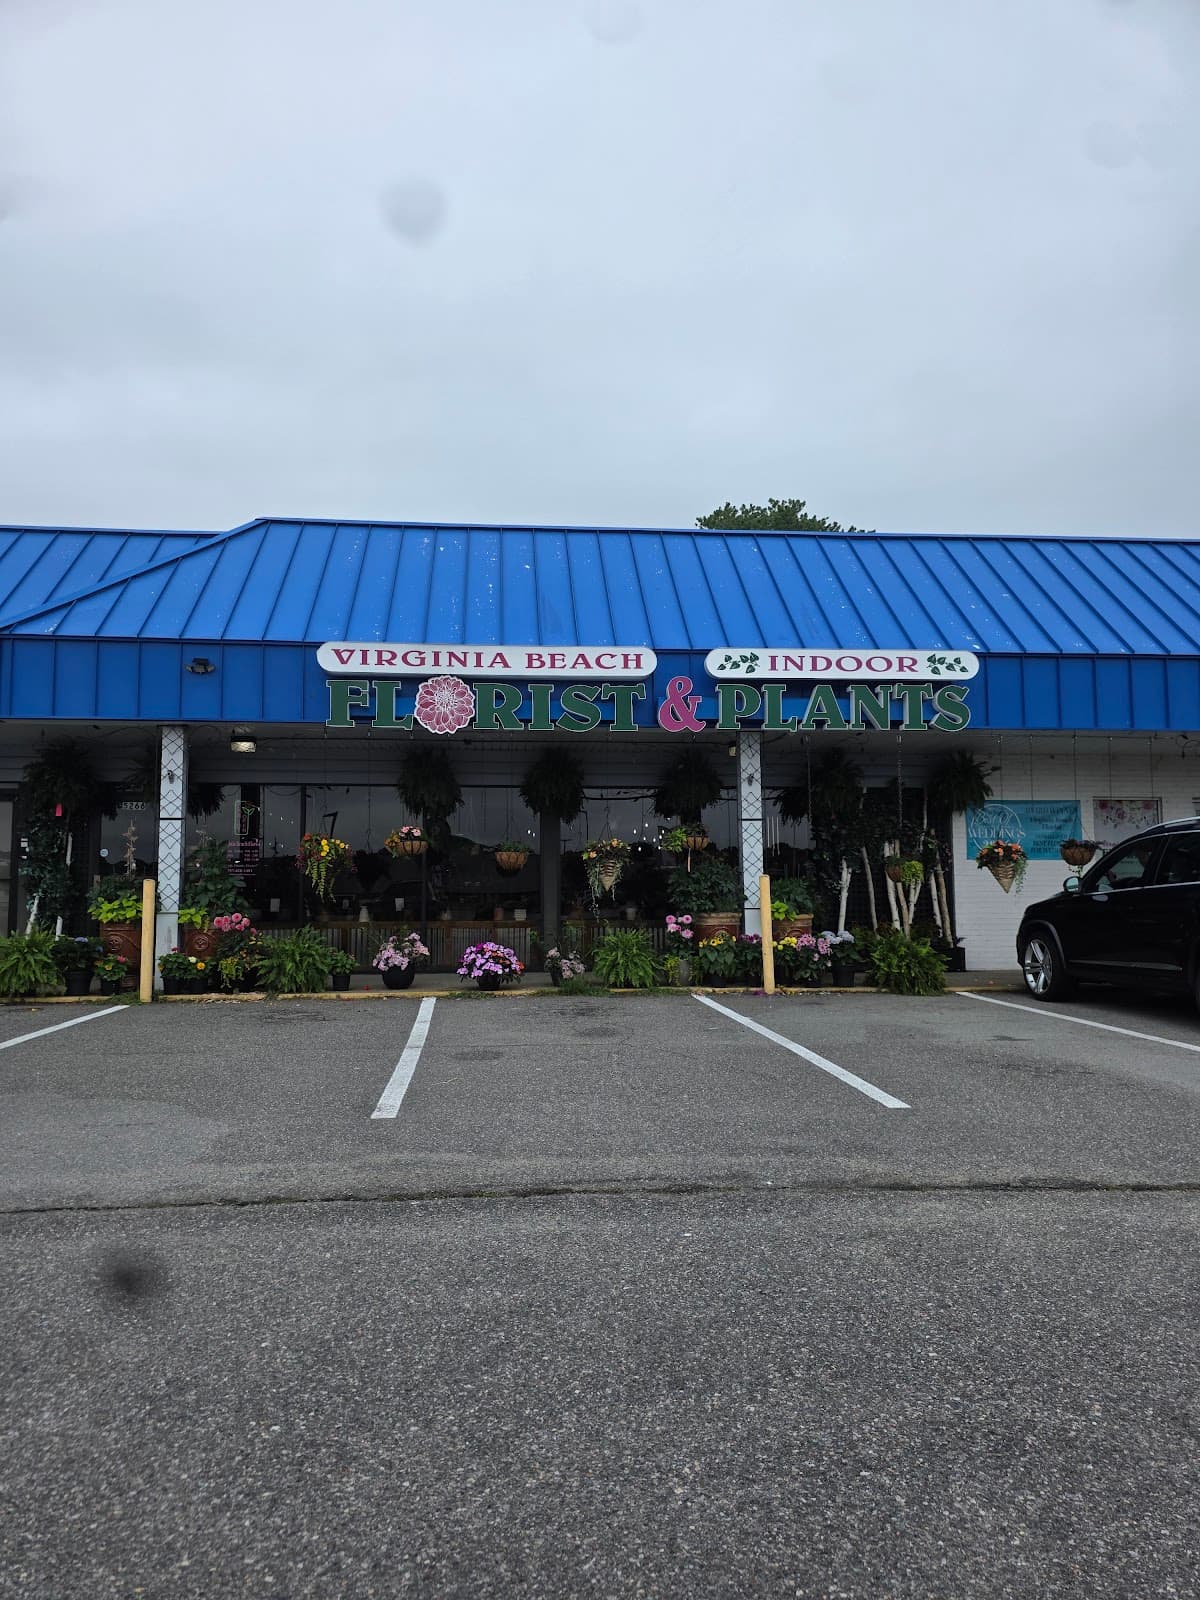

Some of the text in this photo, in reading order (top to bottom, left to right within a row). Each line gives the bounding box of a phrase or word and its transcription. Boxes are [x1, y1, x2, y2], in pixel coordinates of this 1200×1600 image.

[331, 648, 644, 670] VIRGINIA BEACH
[768, 655, 919, 673] INDOOR
[658, 676, 706, 732] &
[715, 683, 972, 732] PLANTS
